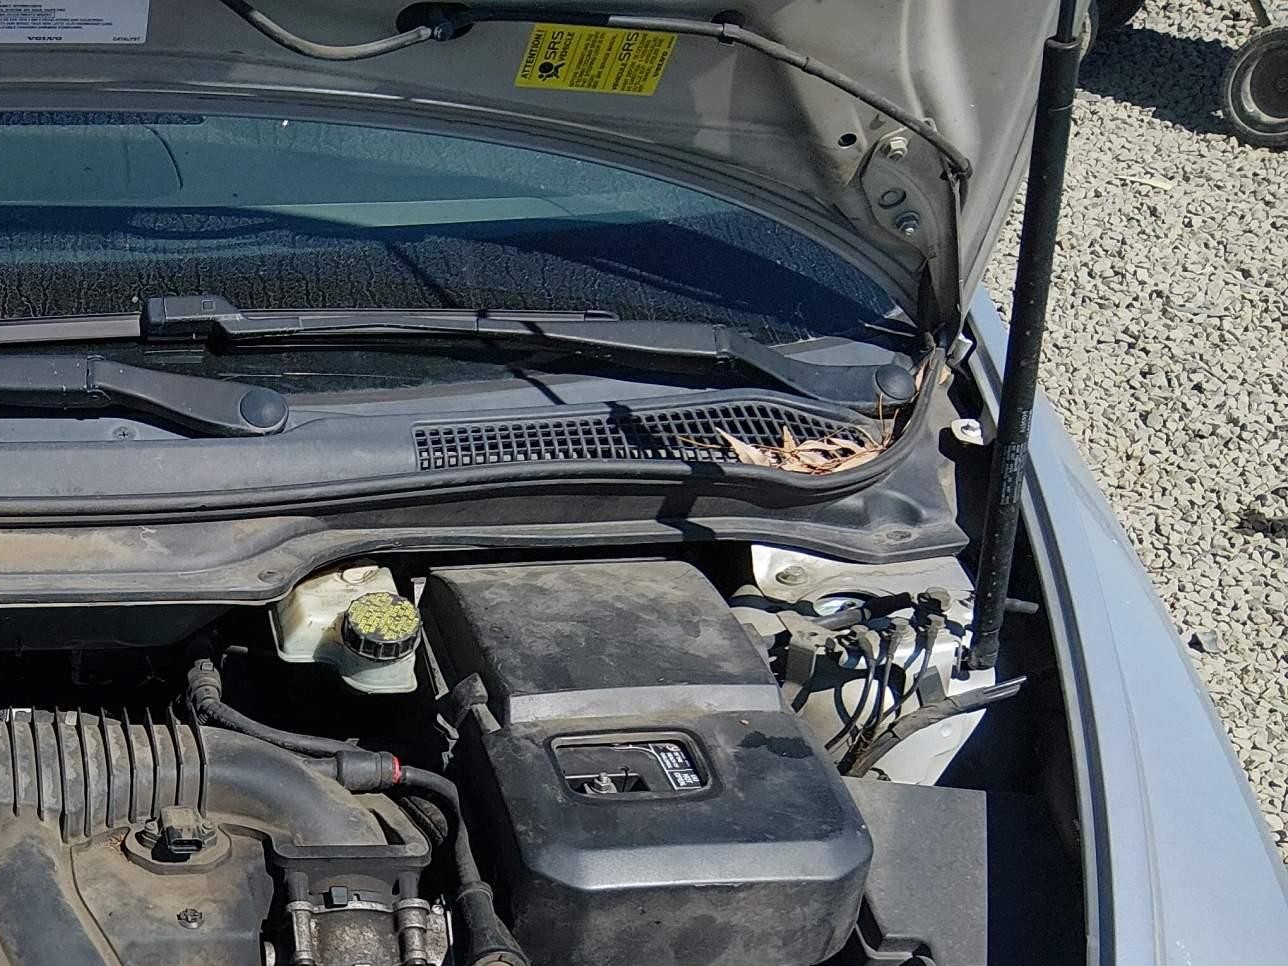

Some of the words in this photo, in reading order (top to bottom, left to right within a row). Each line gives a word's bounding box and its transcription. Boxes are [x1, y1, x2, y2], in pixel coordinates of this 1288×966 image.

[545, 31, 564, 61] SRS
[558, 32, 575, 62] VEHICLE
[619, 32, 639, 61] SRS
